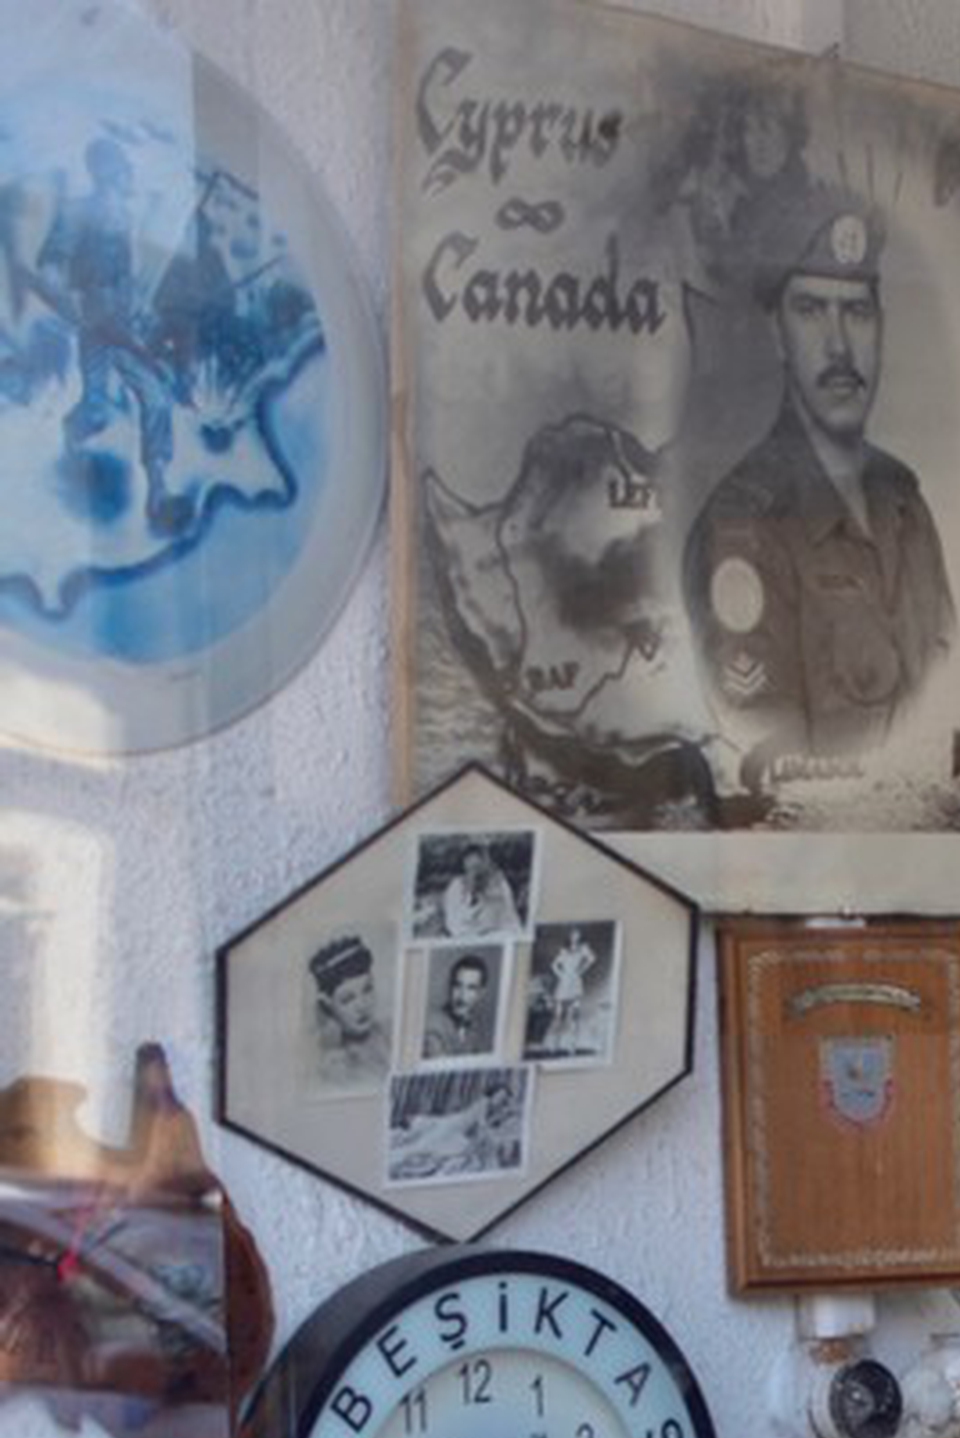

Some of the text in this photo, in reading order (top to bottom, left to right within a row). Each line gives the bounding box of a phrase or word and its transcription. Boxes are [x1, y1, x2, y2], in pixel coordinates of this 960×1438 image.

[416, 47, 622, 195] Cyprus
[422, 231, 666, 334] Canada
[460, 1359, 492, 1405] 12
[530, 1375, 545, 1416] 1
[400, 1388, 427, 1434] 11
